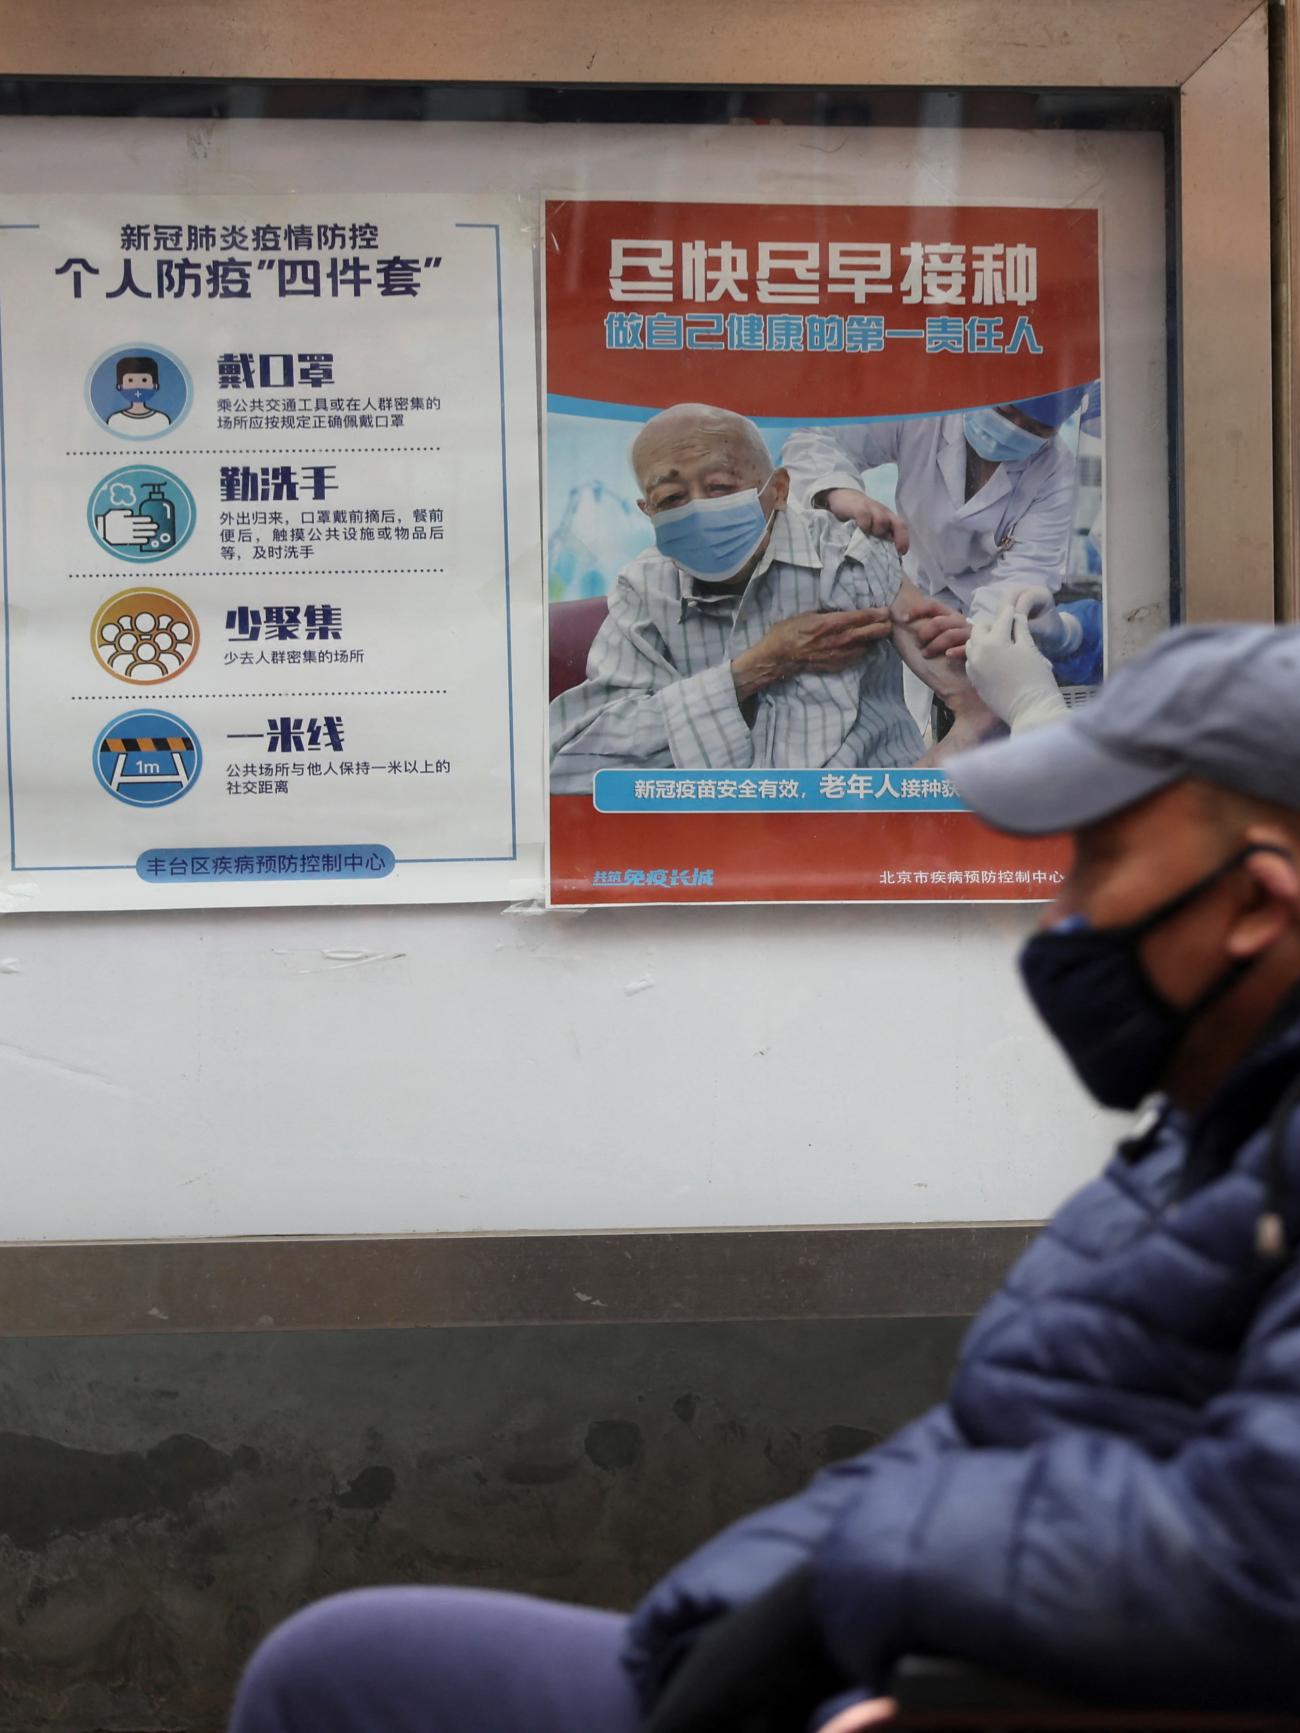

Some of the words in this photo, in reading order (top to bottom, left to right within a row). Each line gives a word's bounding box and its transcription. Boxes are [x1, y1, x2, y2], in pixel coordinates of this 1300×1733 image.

[121, 223, 378, 251] 新冠肺炎疫情防控
[609, 238, 1038, 306] 尽快尽早接种
[604, 312, 1043, 353] 做自己健康的第一责任人
[217, 353, 334, 388] 戴口罩
[217, 396, 441, 413] 乘公共交通工具或在人群密集的
[218, 414, 403, 429] 场所应按规定正确佩戴口罩
[220, 466, 338, 501] 勤洗手
[219, 508, 444, 526] 外出归来，口罩戴前摘后，餐前
[219, 527, 445, 544] 便后，触摸公共设施或物品后
[221, 545, 314, 560] 等，及时洗手
[226, 605, 342, 641] 少聚集
[224, 650, 364, 665] 少去人群密集的场所
[227, 717, 344, 752] 一米线
[136, 760, 160, 775] 1m
[227, 760, 450, 777] 公共场所与他人保持一米以上的
[227, 780, 288, 794] 社交距离
[147, 852, 386, 876] 丰台区疾病预防控制中心
[880, 870, 1063, 884] 北京市疾病预防控制中心
